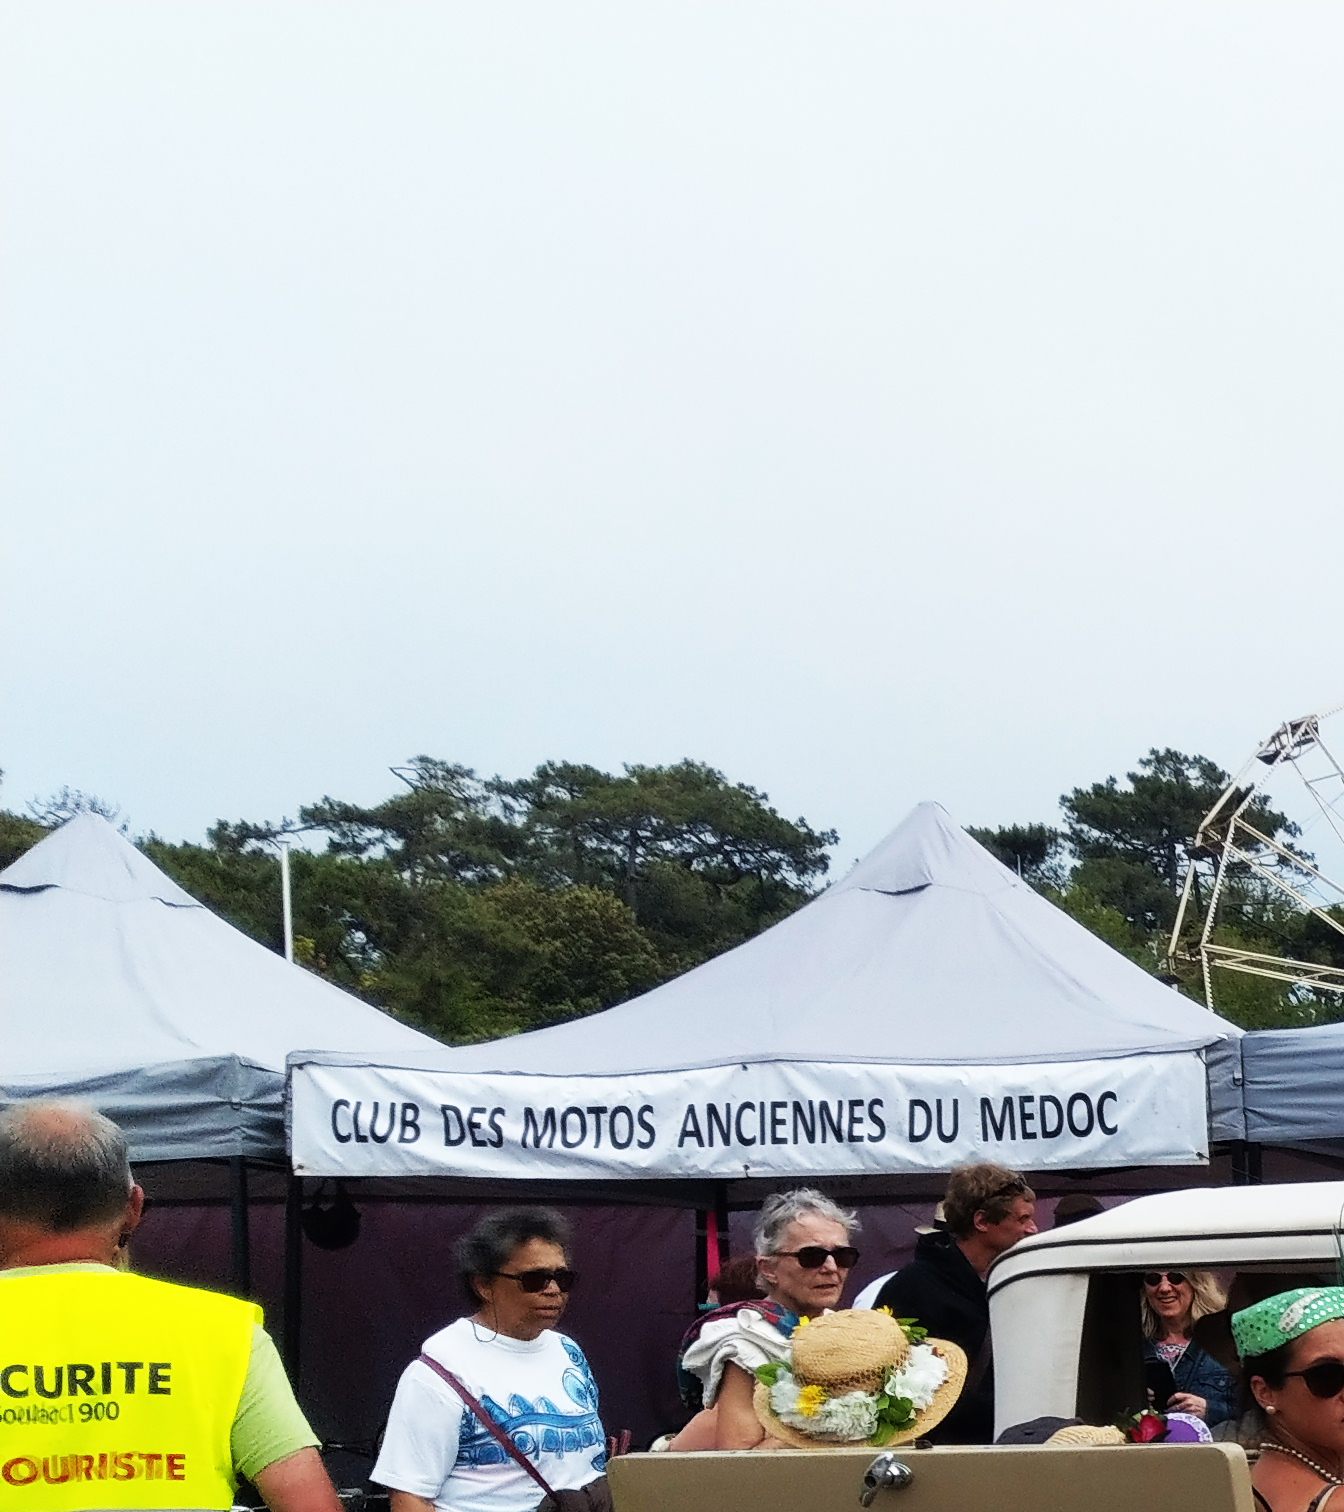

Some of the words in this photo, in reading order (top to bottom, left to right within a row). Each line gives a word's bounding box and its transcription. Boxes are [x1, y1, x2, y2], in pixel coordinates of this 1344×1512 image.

[330, 1098, 421, 1144] CLUB
[440, 1103, 506, 1149] DES
[520, 1103, 657, 1151] MOTOS
[677, 1097, 887, 1149] ANCIENNES
[907, 1097, 960, 1145] DU
[979, 1089, 1119, 1143] MEDOC
